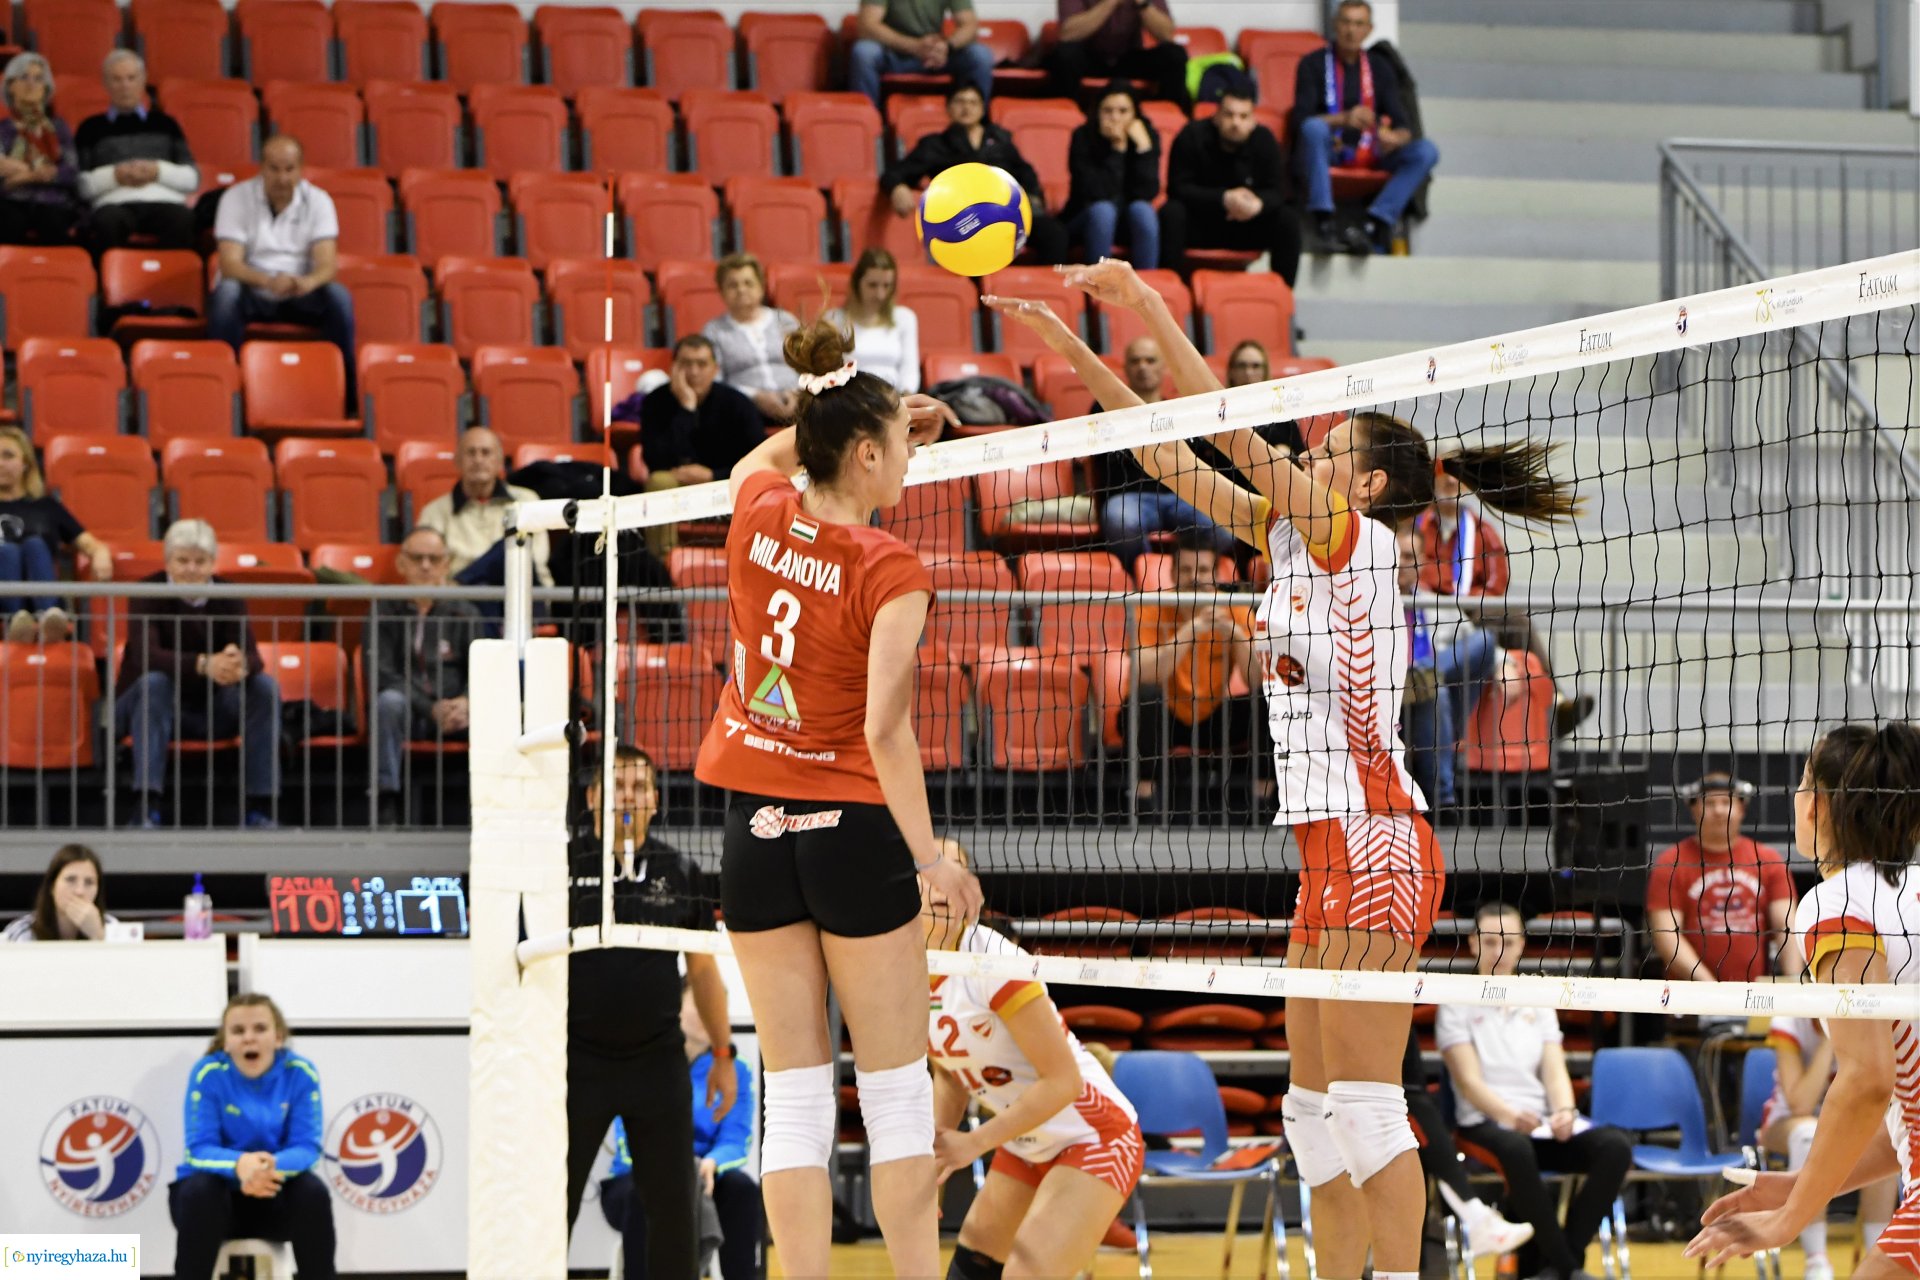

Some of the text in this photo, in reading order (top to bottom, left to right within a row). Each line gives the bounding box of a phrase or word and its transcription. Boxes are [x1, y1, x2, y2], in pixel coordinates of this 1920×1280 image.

[1859, 271, 1897, 298] FATUM
[1579, 328, 1612, 353] FATUM
[749, 532, 841, 595] MILANOVA
[761, 589, 801, 668] 3
[271, 877, 333, 891] FATUM
[279, 894, 336, 932] 10
[419, 894, 442, 932] 1
[1481, 980, 1507, 1001] FATUM
[1745, 989, 1774, 1010] FATUM
[70, 1099, 130, 1116] FATUM
[353, 1095, 412, 1113] FATUM
